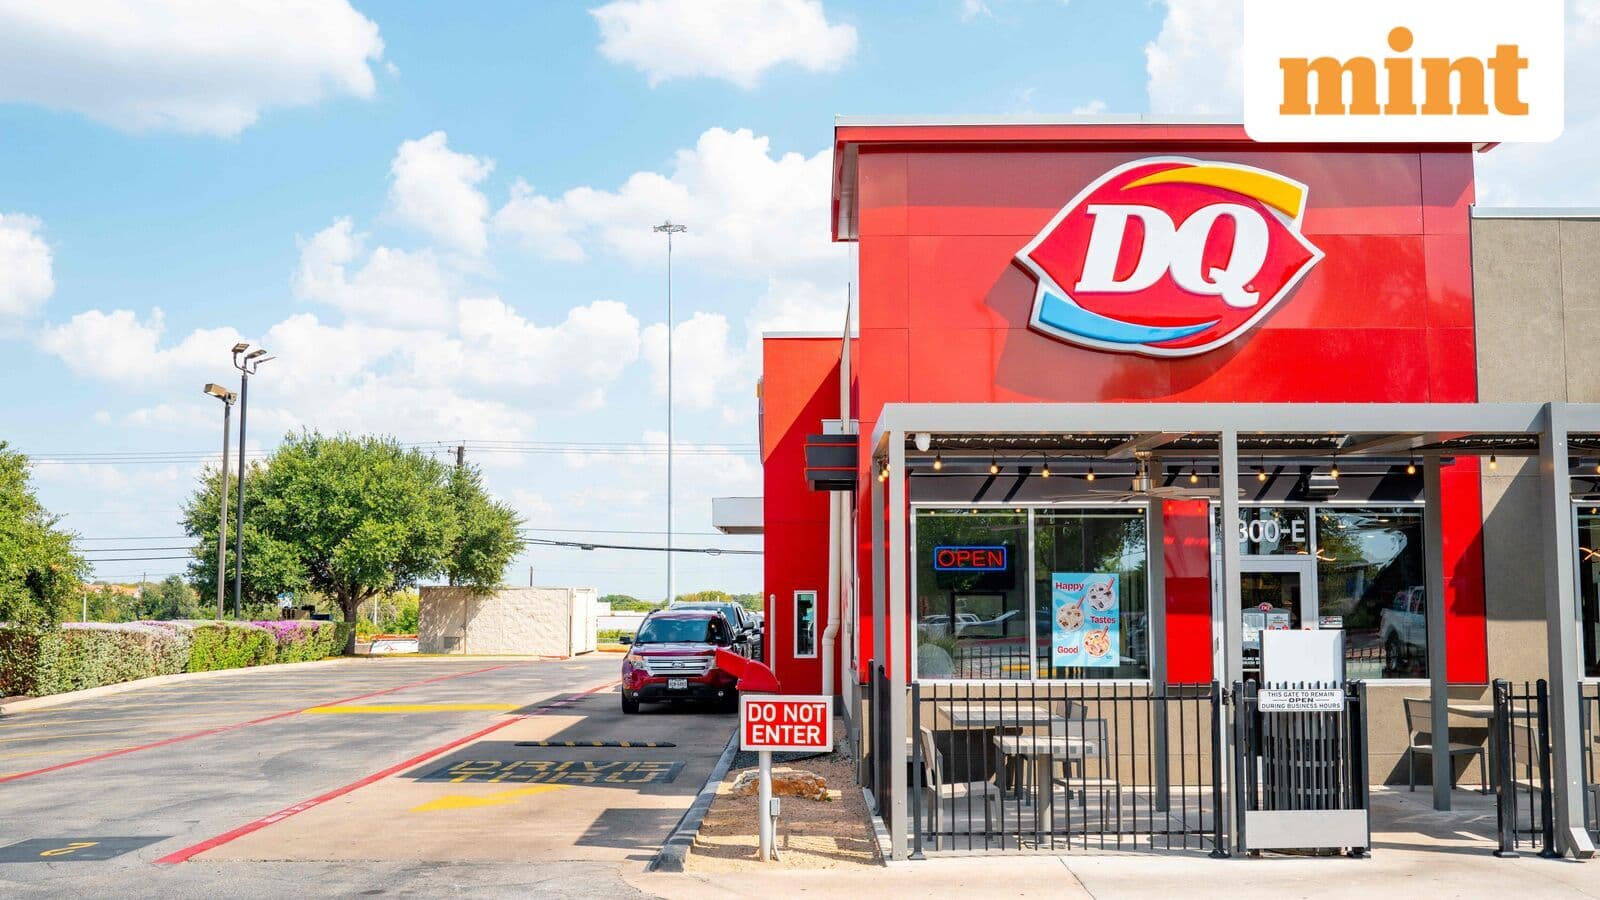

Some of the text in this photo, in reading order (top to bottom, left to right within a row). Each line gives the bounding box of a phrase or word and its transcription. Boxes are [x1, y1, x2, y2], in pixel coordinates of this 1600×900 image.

[1074, 203, 1270, 308] DQ
[937, 549, 1003, 567] OPEN
[1055, 582, 1085, 591] Happy
[1090, 615, 1116, 624] Tastes
[1057, 645, 1079, 654] Good
[748, 703, 826, 723] DO NOT
[752, 724, 821, 744] ENTER
[449, 760, 675, 773] DRIVE
[450, 770, 660, 784] THRU
